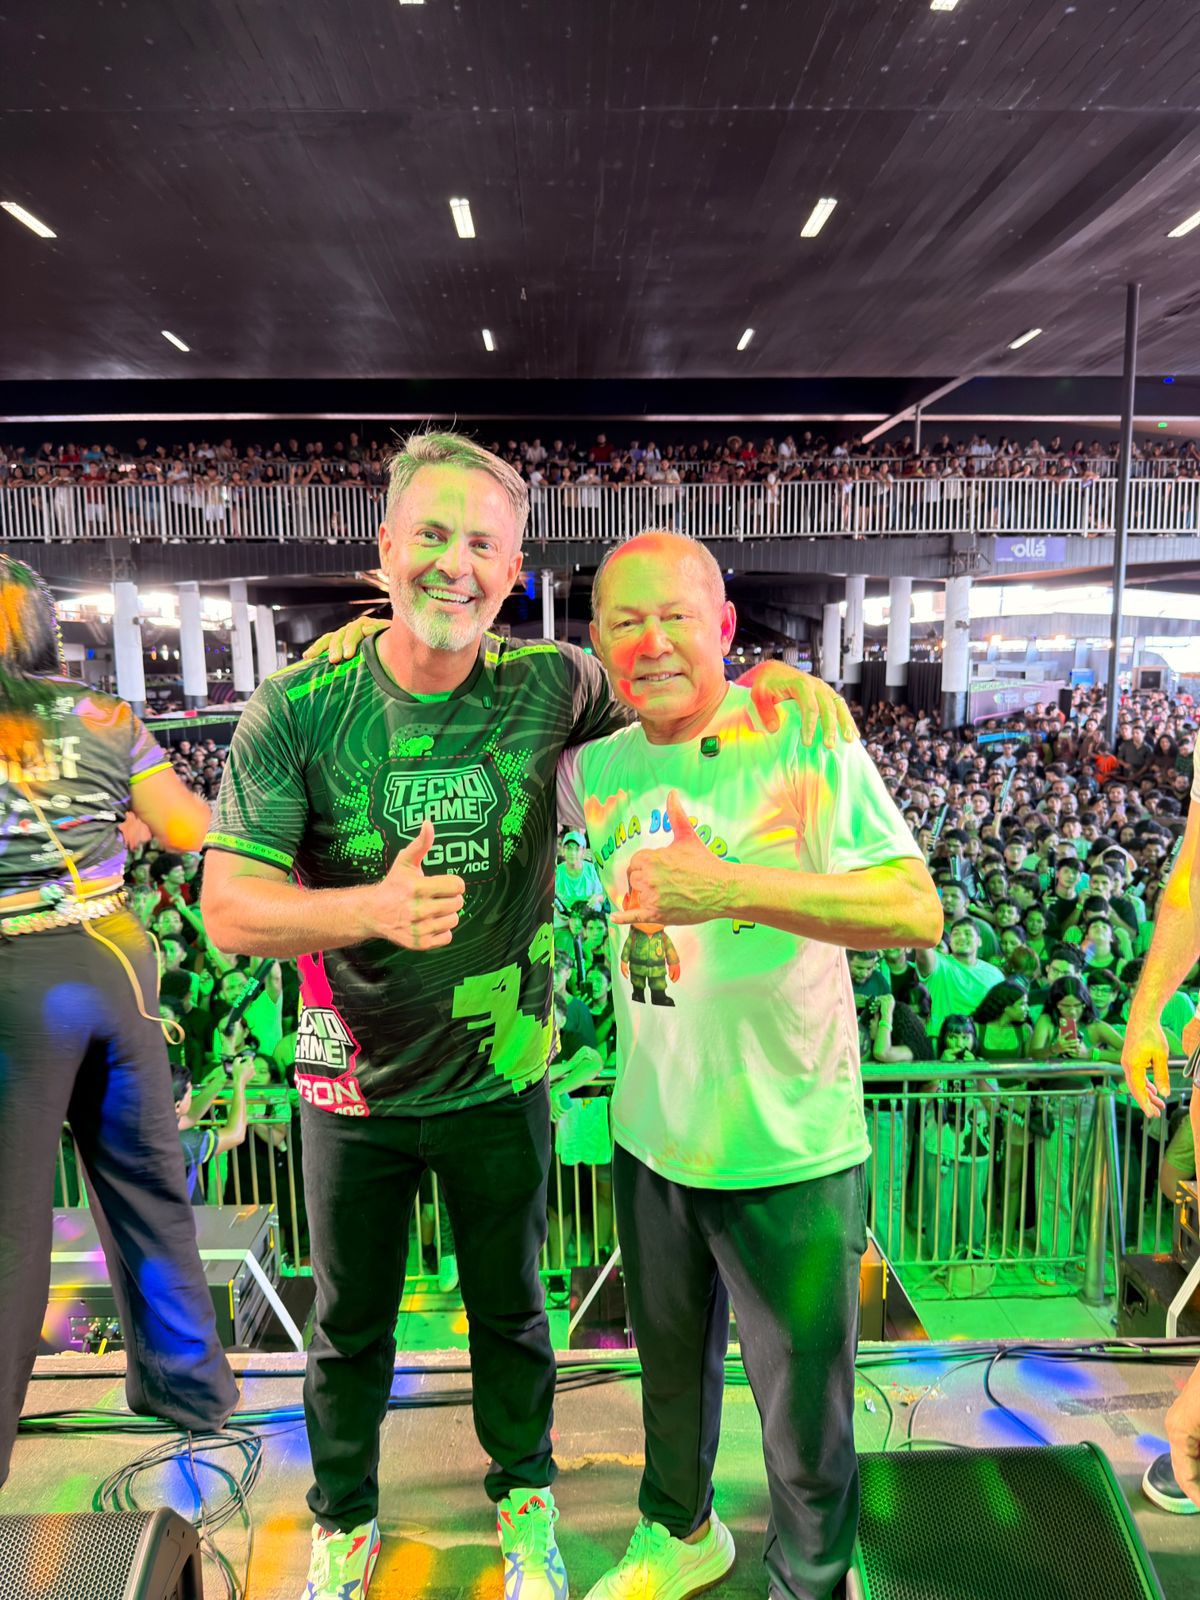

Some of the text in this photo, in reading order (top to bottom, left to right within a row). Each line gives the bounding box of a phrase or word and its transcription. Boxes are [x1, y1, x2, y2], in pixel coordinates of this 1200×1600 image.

[1014, 538, 1046, 558] ollá
[394, 773, 487, 808] TECNO
[406, 799, 480, 828] GAME
[422, 838, 490, 866] GON
[594, 815, 641, 870] INHA
[463, 860, 490, 874] AOC
[298, 1011, 347, 1041] CNO
[295, 1077, 361, 1106] GON
